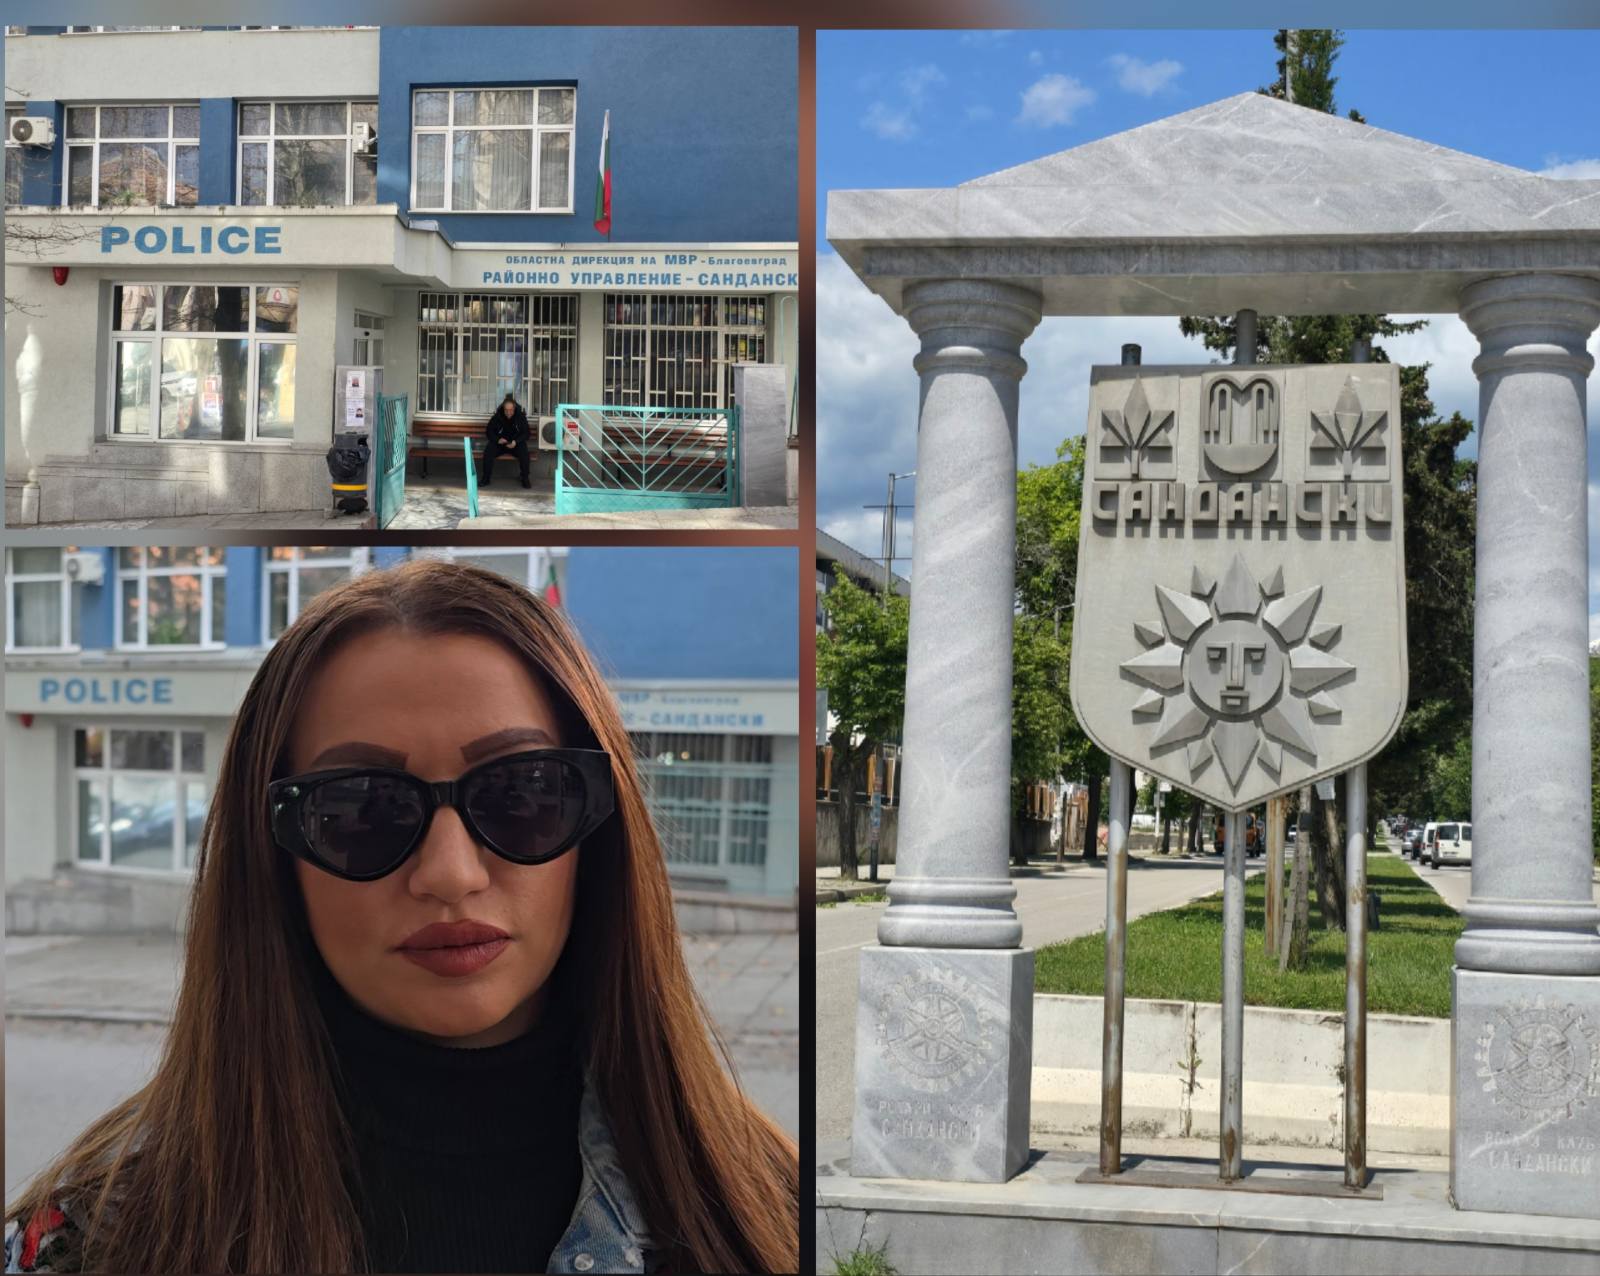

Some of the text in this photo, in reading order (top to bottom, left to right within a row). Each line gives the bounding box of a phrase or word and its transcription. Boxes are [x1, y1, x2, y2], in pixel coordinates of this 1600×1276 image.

[101, 226, 281, 255] POLICE
[506, 256, 564, 265] ОБЛАСТНА
[572, 256, 634, 266] ДИРЕКЦИЯ
[641, 257, 656, 265] НА
[664, 255, 697, 265] МВР
[483, 269, 560, 285] РАЙОННО
[571, 272, 681, 286] УПРАВЛЕНИЕ
[39, 679, 173, 704] POLICE
